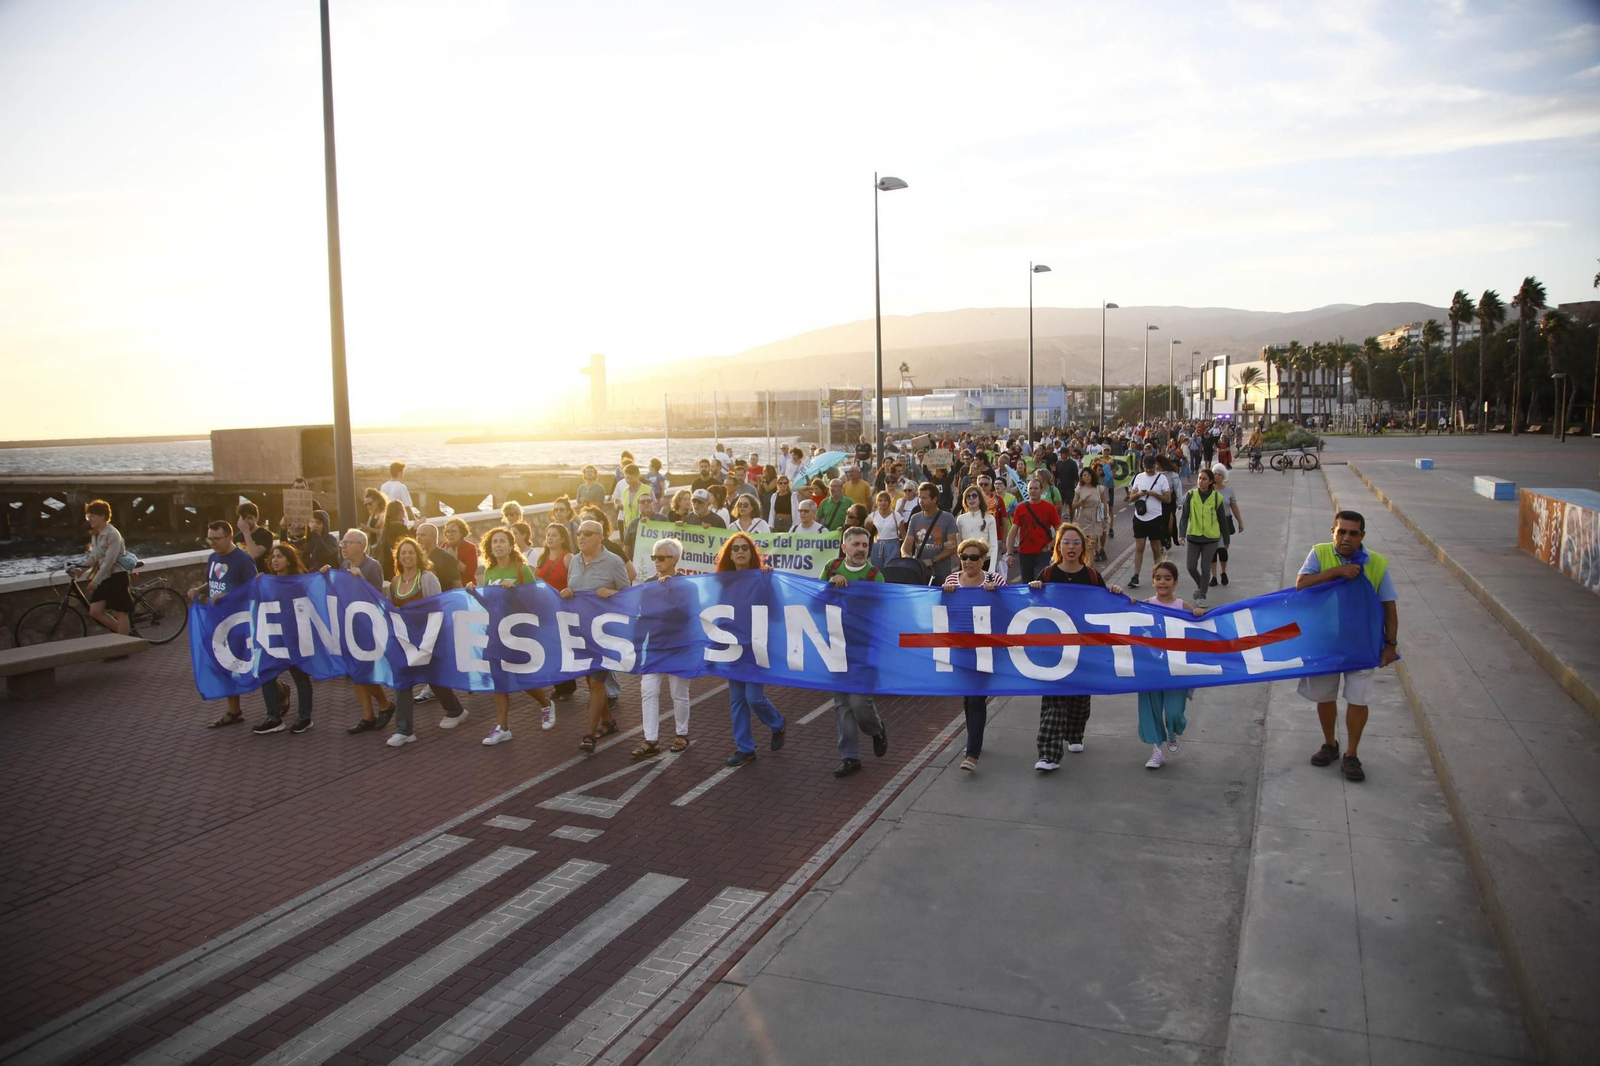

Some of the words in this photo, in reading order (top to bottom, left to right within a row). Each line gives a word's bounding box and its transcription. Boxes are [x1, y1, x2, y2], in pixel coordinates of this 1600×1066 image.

[640, 525, 659, 539] Los
[661, 529, 705, 544] vecinos
[708, 535, 716, 548] y
[773, 535, 792, 548] del
[796, 538, 840, 551] parque
[212, 595, 637, 674] GENOVESES
[699, 604, 848, 673] SIN
[931, 605, 1304, 681] HOTEL
